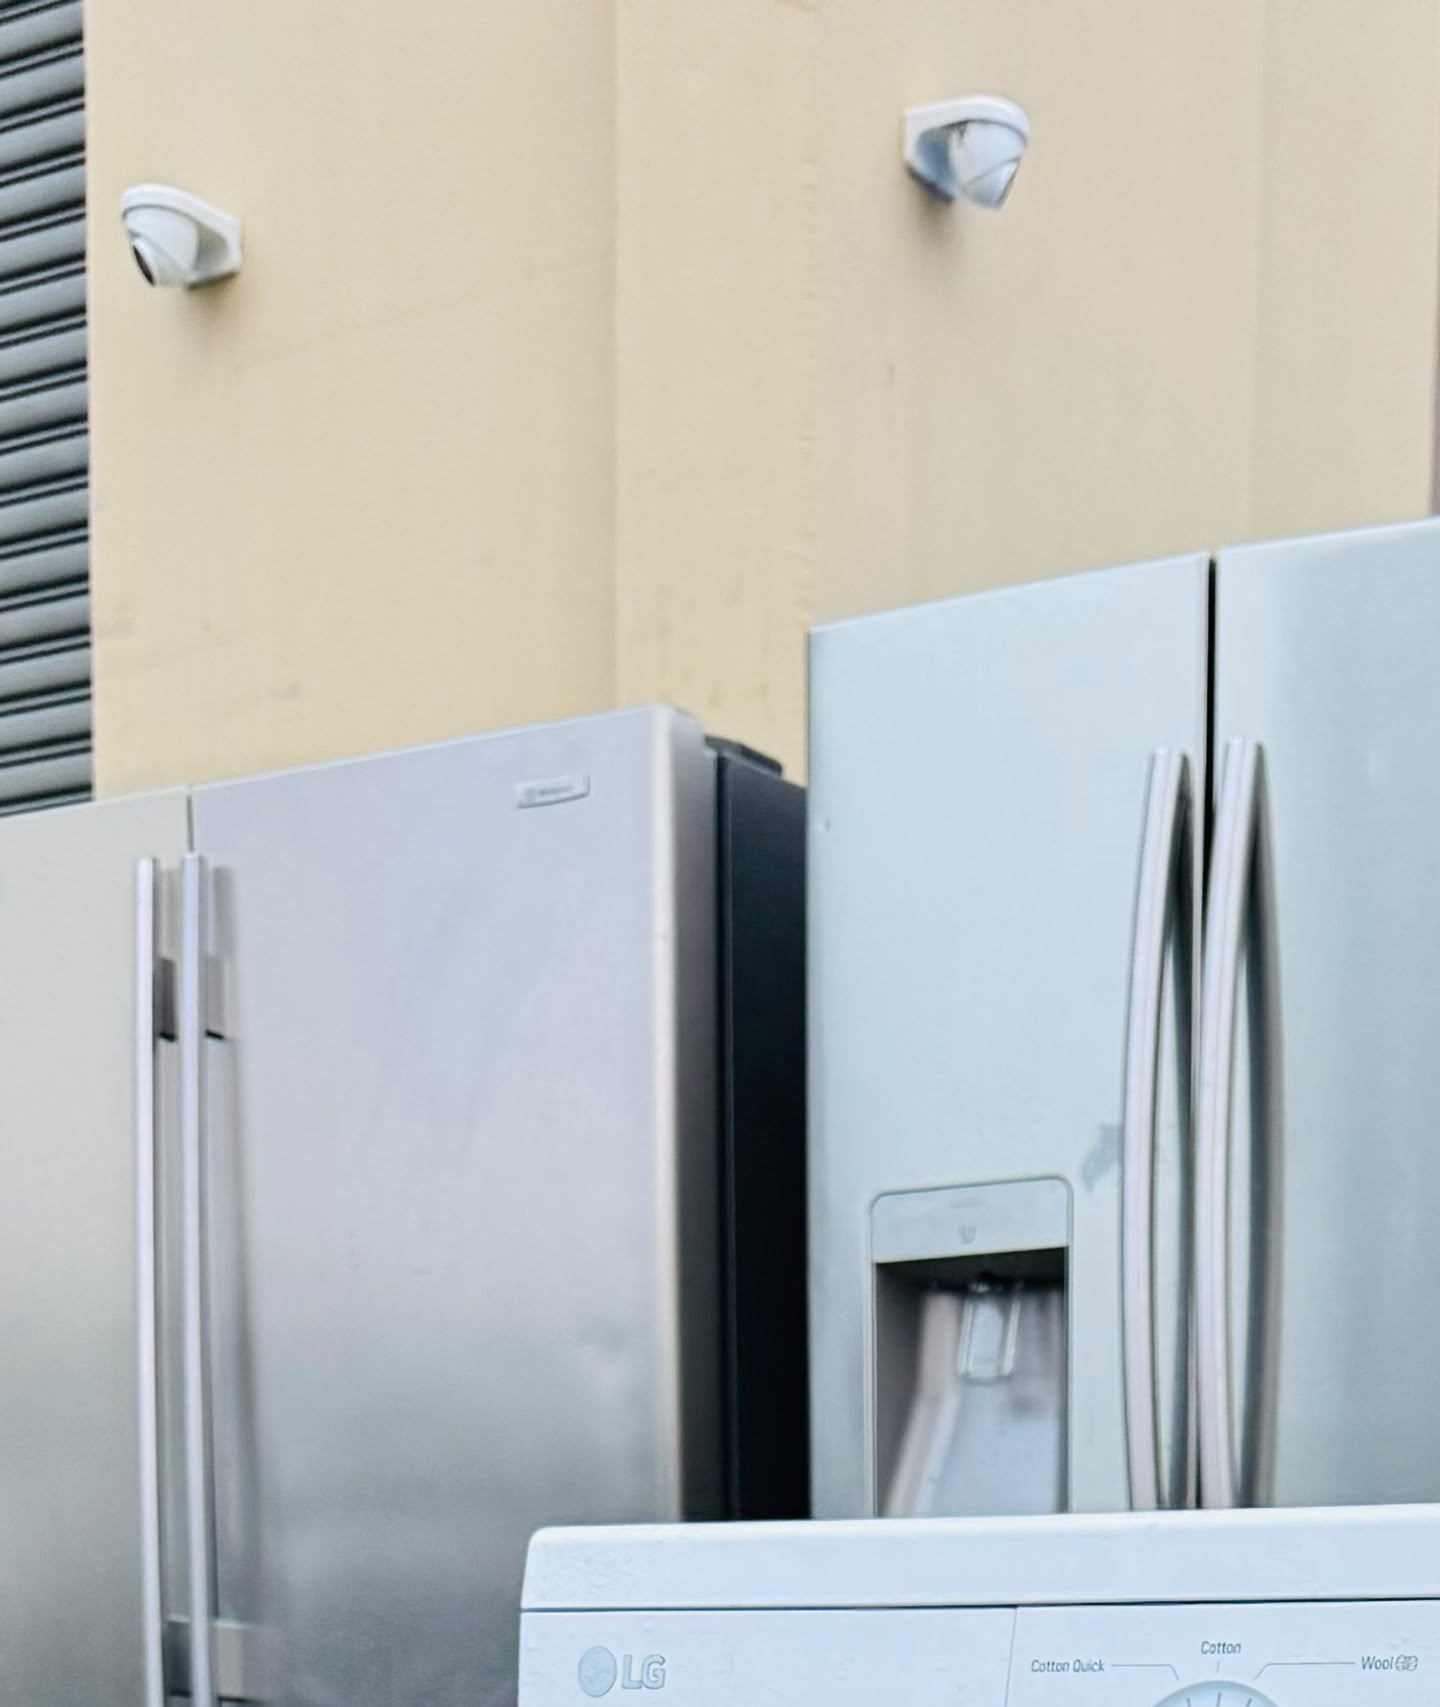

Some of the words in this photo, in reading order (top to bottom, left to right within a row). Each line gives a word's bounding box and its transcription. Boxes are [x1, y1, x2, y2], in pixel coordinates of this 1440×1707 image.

[1201, 1639, 1241, 1656] Cotton
[1031, 1658, 1069, 1674] Cotton
[1072, 1658, 1106, 1675] Quick
[1361, 1654, 1394, 1670] Wool
[621, 1654, 666, 1690] LG
